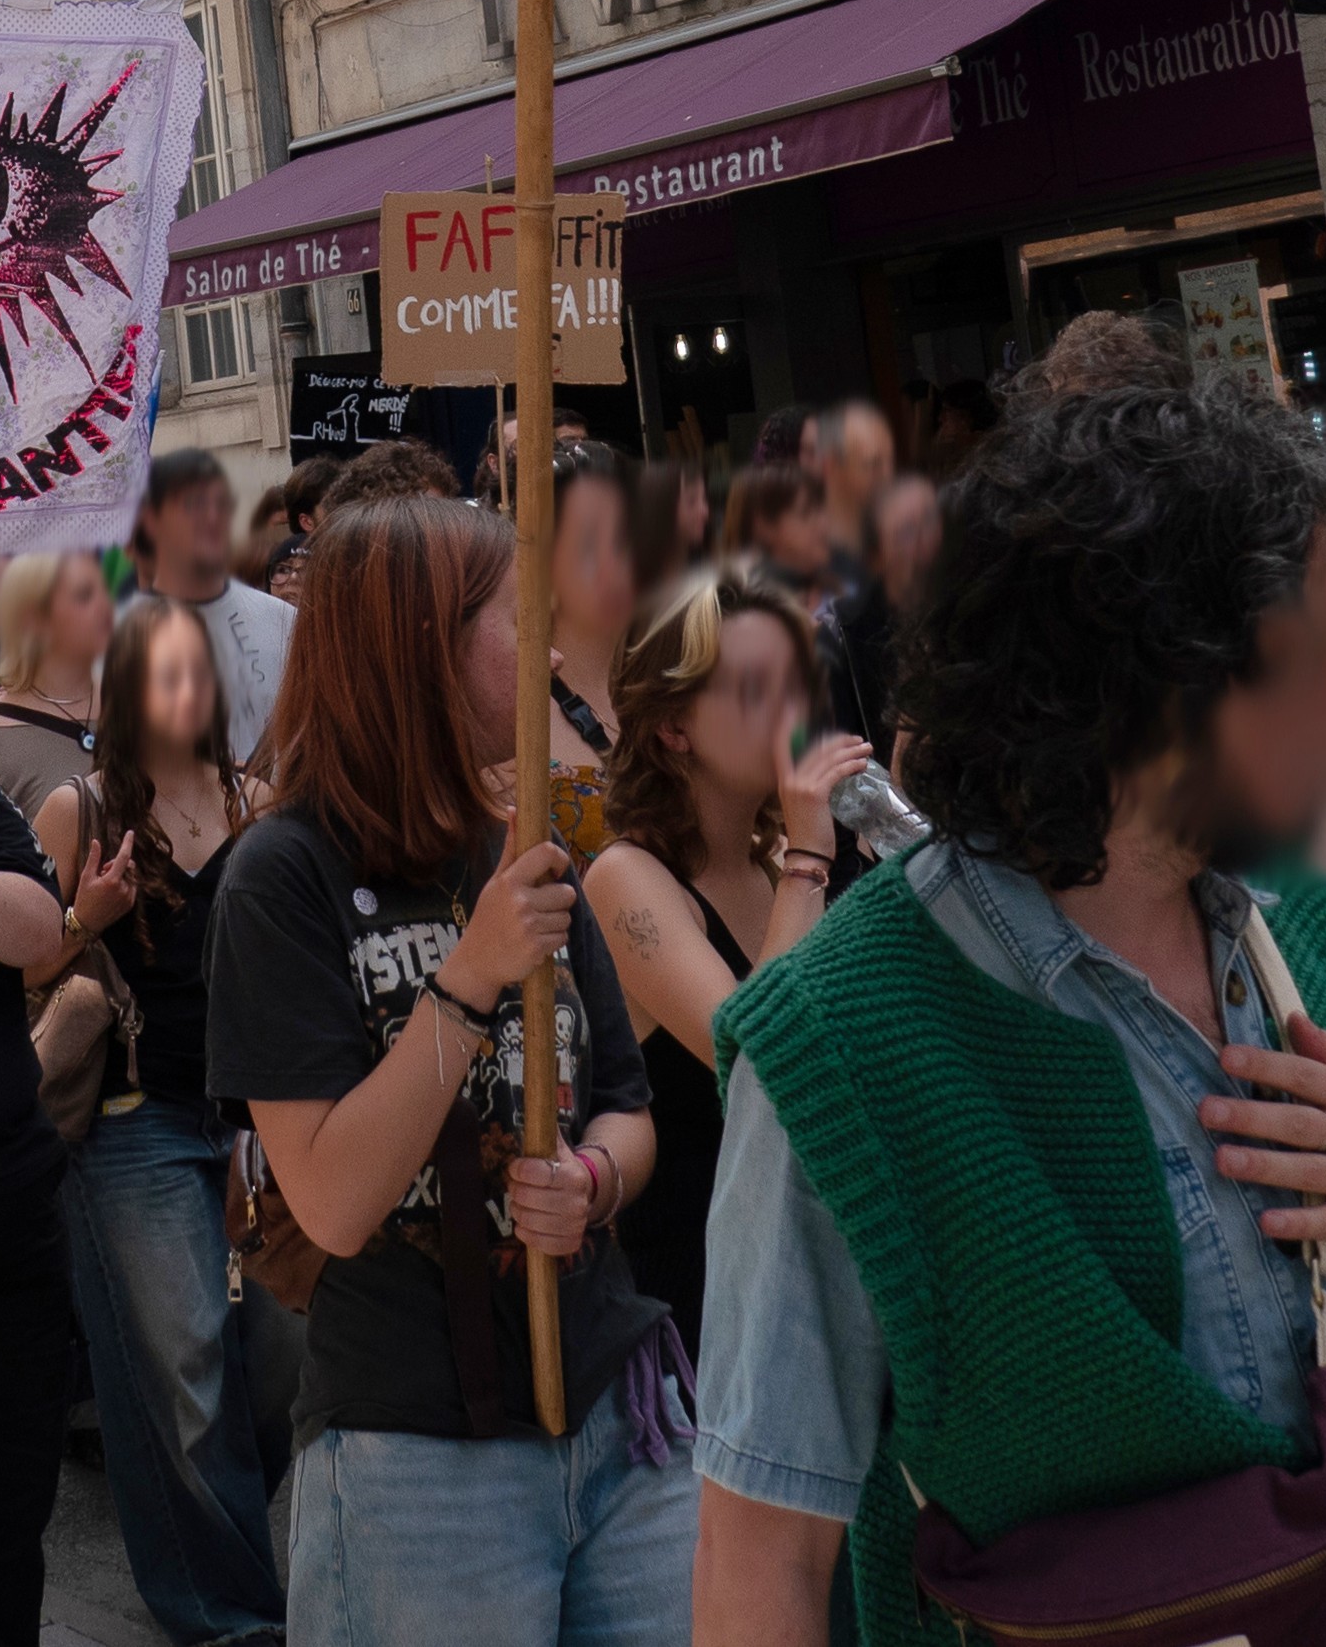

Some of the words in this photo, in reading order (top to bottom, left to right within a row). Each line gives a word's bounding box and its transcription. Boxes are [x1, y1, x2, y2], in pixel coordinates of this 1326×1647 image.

[968, 50, 1032, 128] Thé
[185, 257, 247, 299] Salon
[259, 245, 285, 283] de
[292, 232, 343, 276] Thé
[347, 290, 360, 313] 66
[397, 287, 519, 335] COMME
